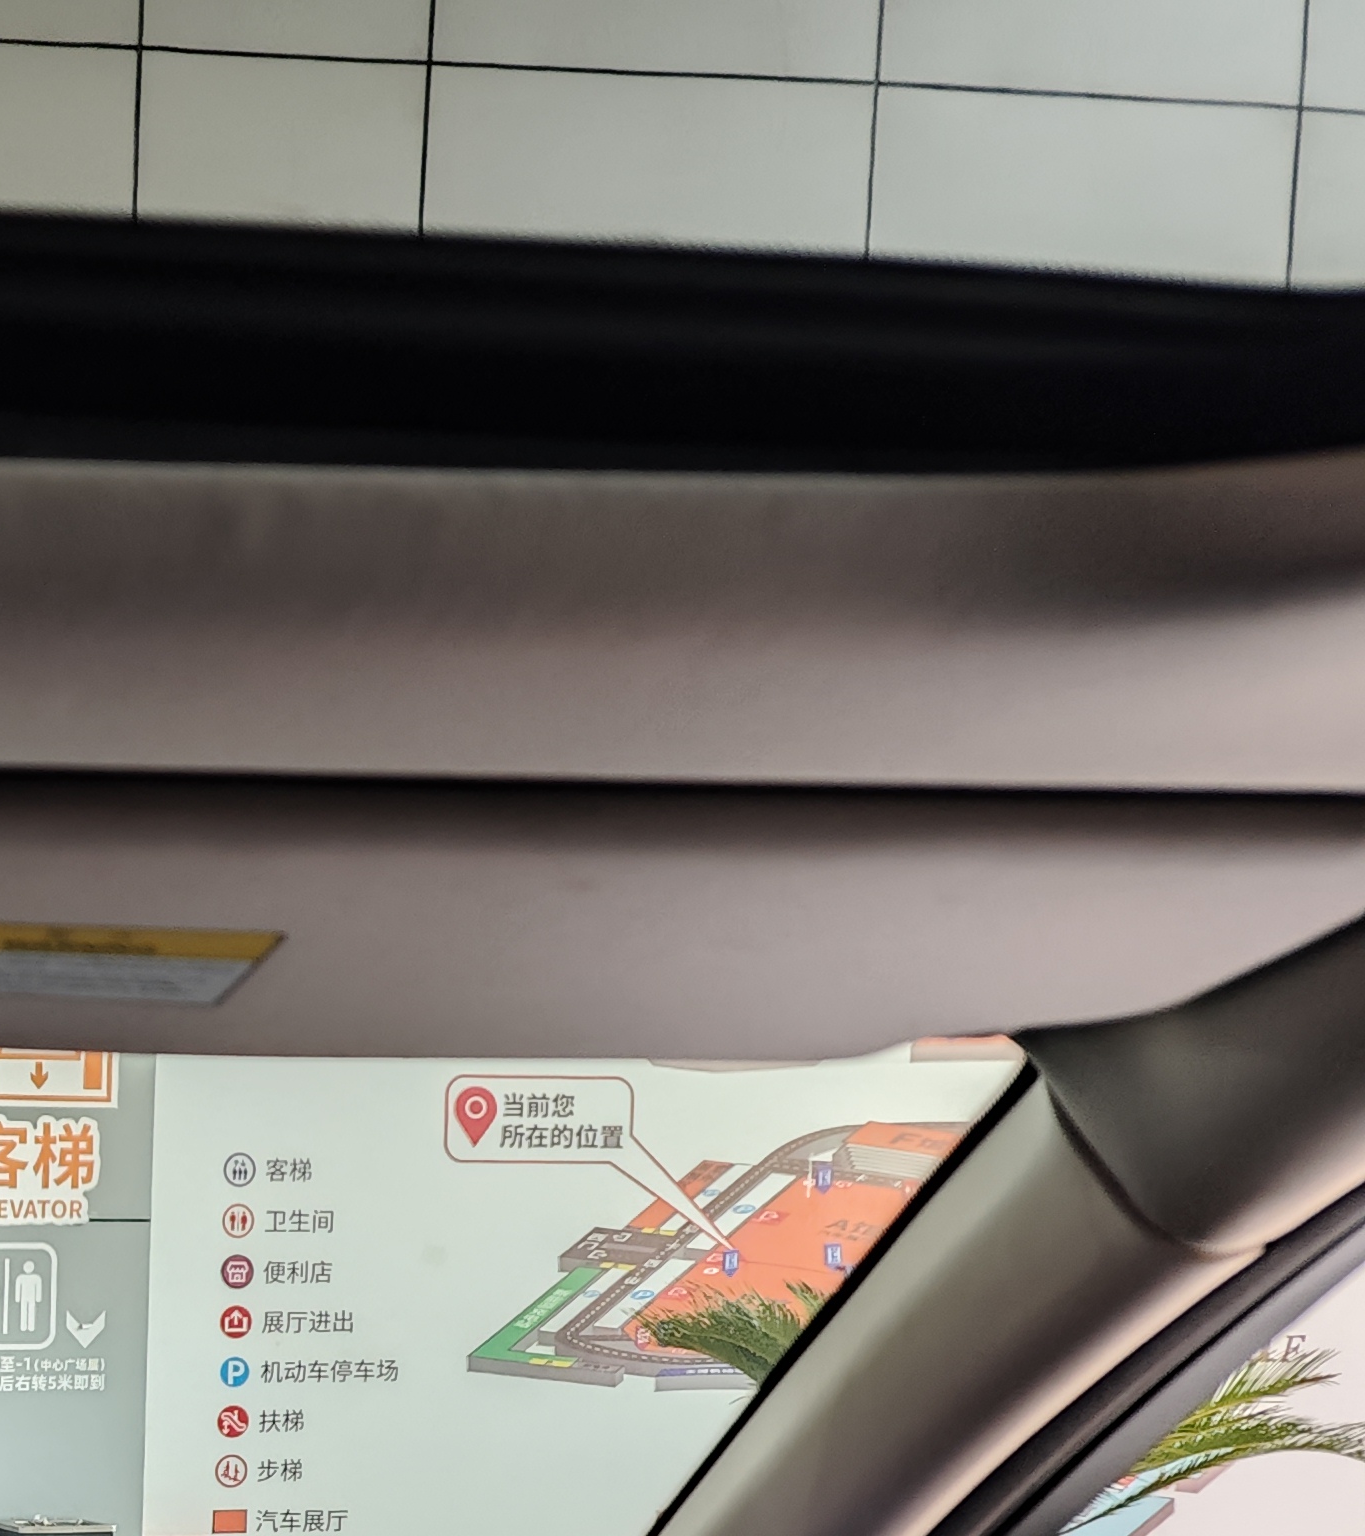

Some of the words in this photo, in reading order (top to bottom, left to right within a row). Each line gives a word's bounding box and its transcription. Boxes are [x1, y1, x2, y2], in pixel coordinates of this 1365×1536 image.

[502, 1093, 574, 1118] 当前您
[500, 1124, 623, 1149] 所在的位置
[266, 1158, 312, 1182] 客梯
[265, 1210, 335, 1234] 卫生间
[264, 1260, 333, 1285] 便利店
[261, 1310, 354, 1334] 展厅进出
[260, 1360, 399, 1384] 机动车停车场
[259, 1409, 305, 1433] 扶梯
[257, 1458, 303, 1482] 步梯
[256, 1509, 349, 1533] 汽车展厅
